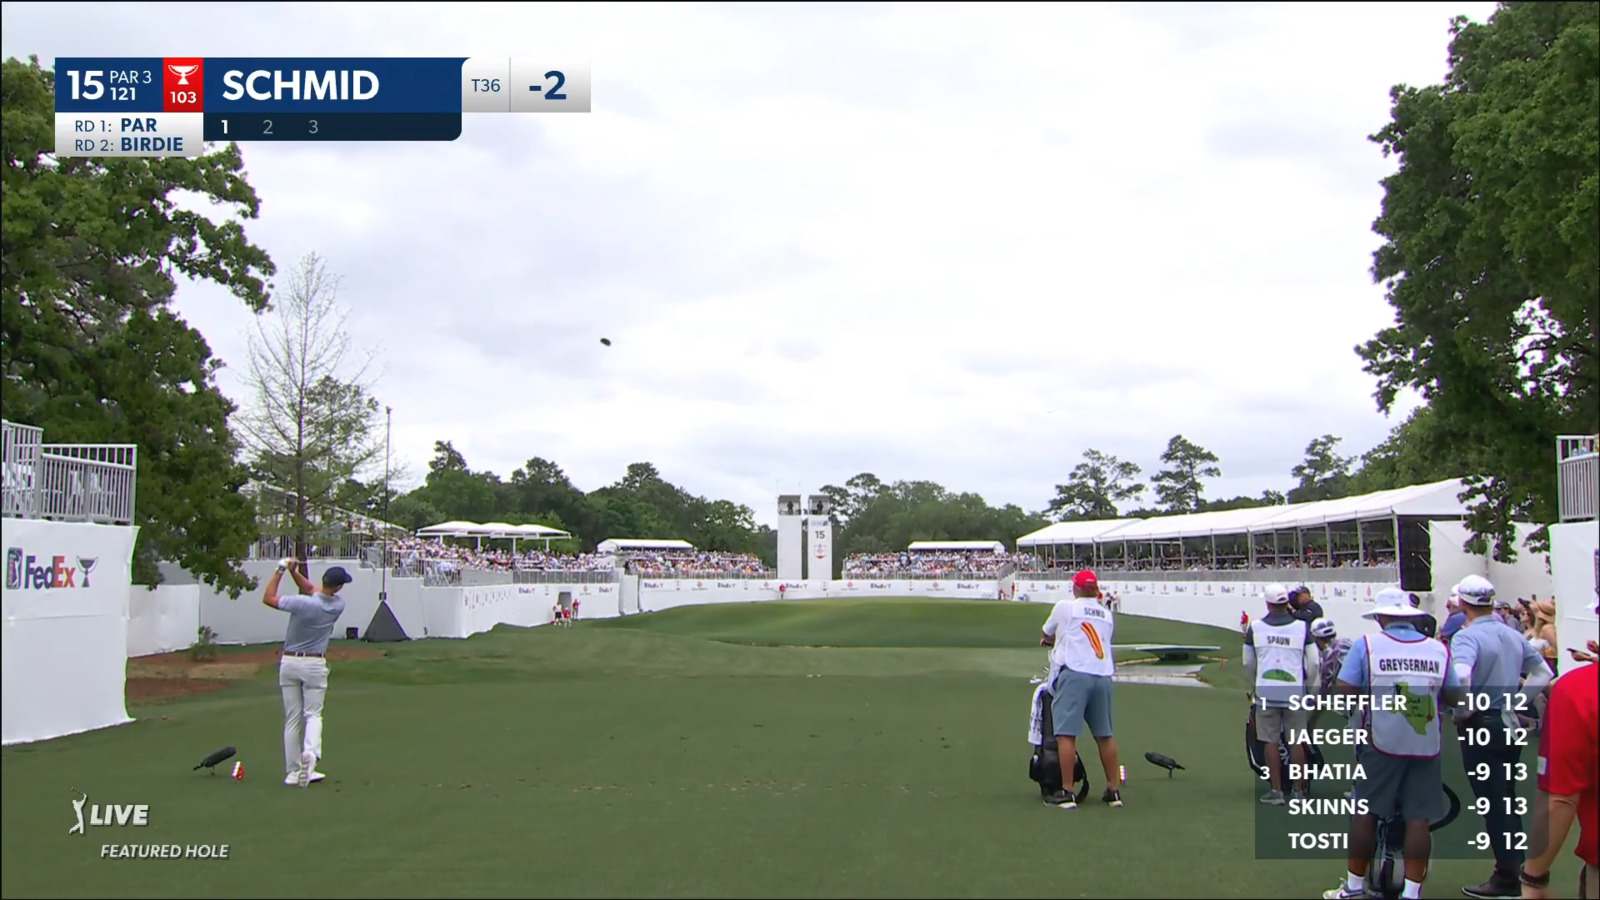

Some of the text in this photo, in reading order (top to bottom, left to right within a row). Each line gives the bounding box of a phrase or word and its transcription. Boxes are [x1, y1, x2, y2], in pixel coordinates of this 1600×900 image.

[815, 530, 826, 540] 15
[24, 555, 76, 590] FedEx
[1379, 658, 1440, 674] GREYSERMAN
